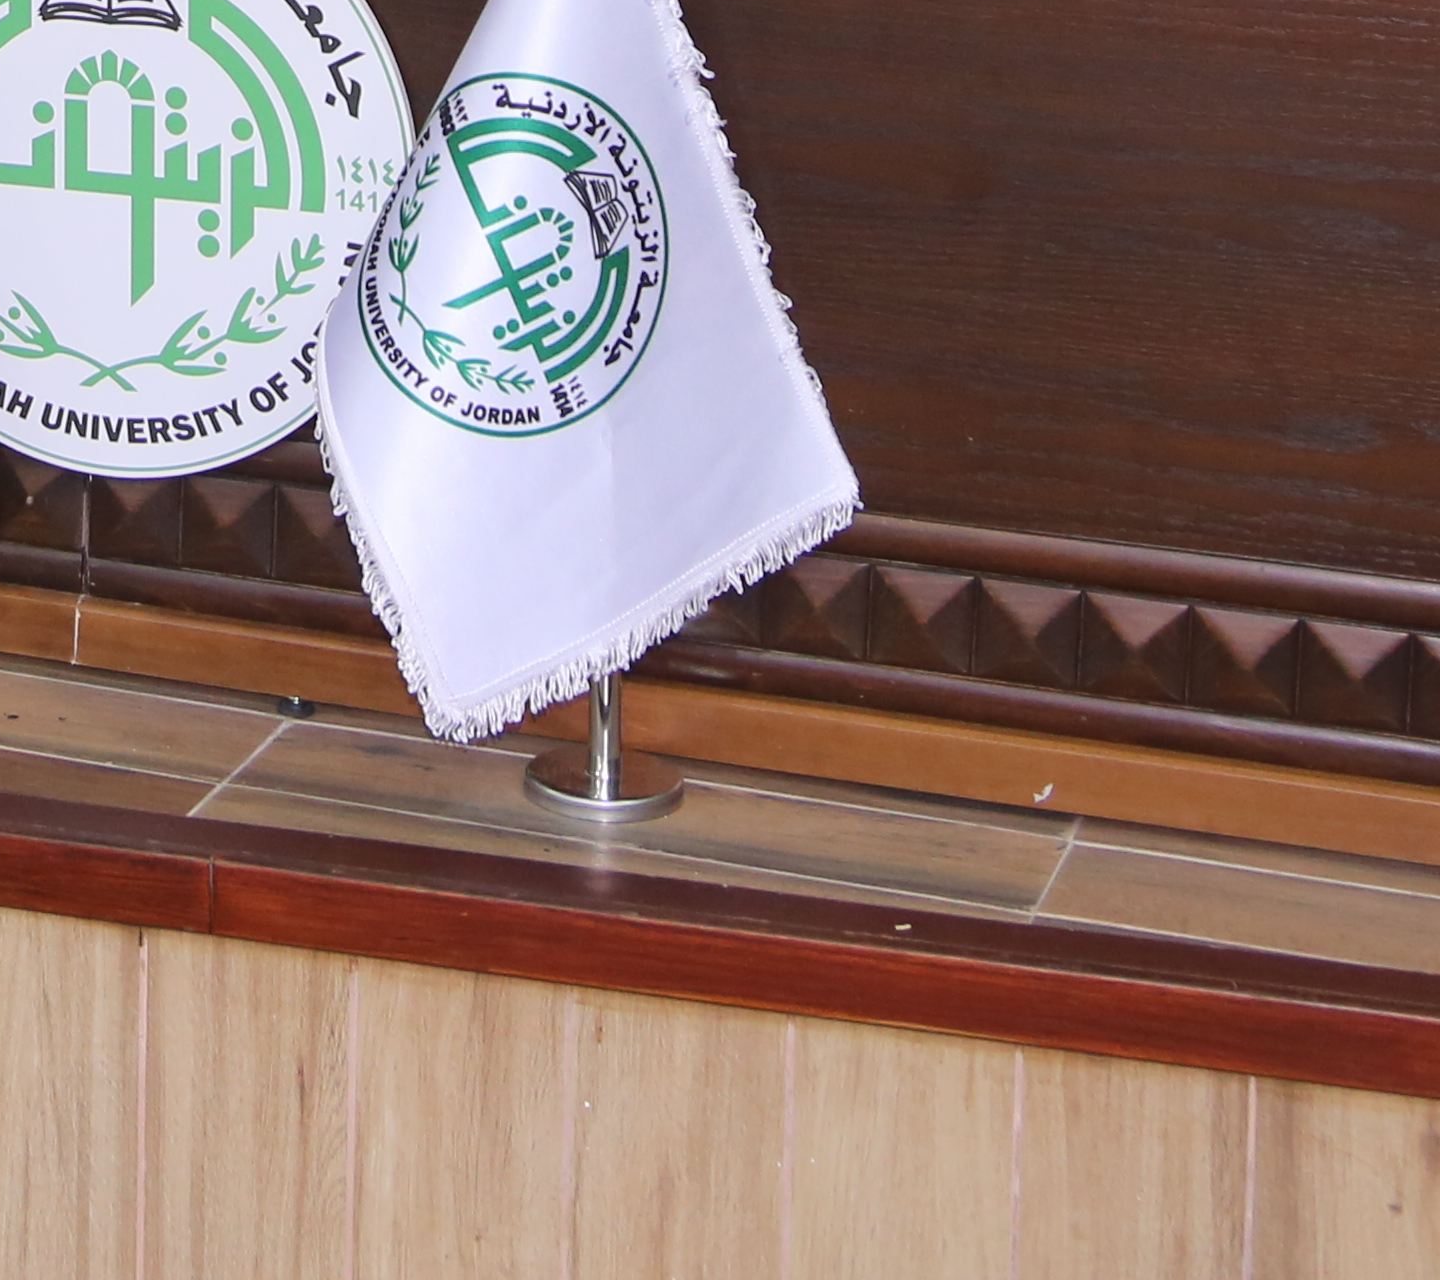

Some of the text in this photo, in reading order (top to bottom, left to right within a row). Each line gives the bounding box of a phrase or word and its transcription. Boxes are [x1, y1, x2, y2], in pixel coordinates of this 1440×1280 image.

[335, 189, 380, 213] 141
[365, 275, 429, 389] UNIVERSITY
[430, 384, 458, 408] OF
[461, 401, 541, 425] JORDAN
[603, 270, 659, 367] جامعة
[40, 399, 245, 445] UNIVERSITY
[249, 371, 292, 414] OF
